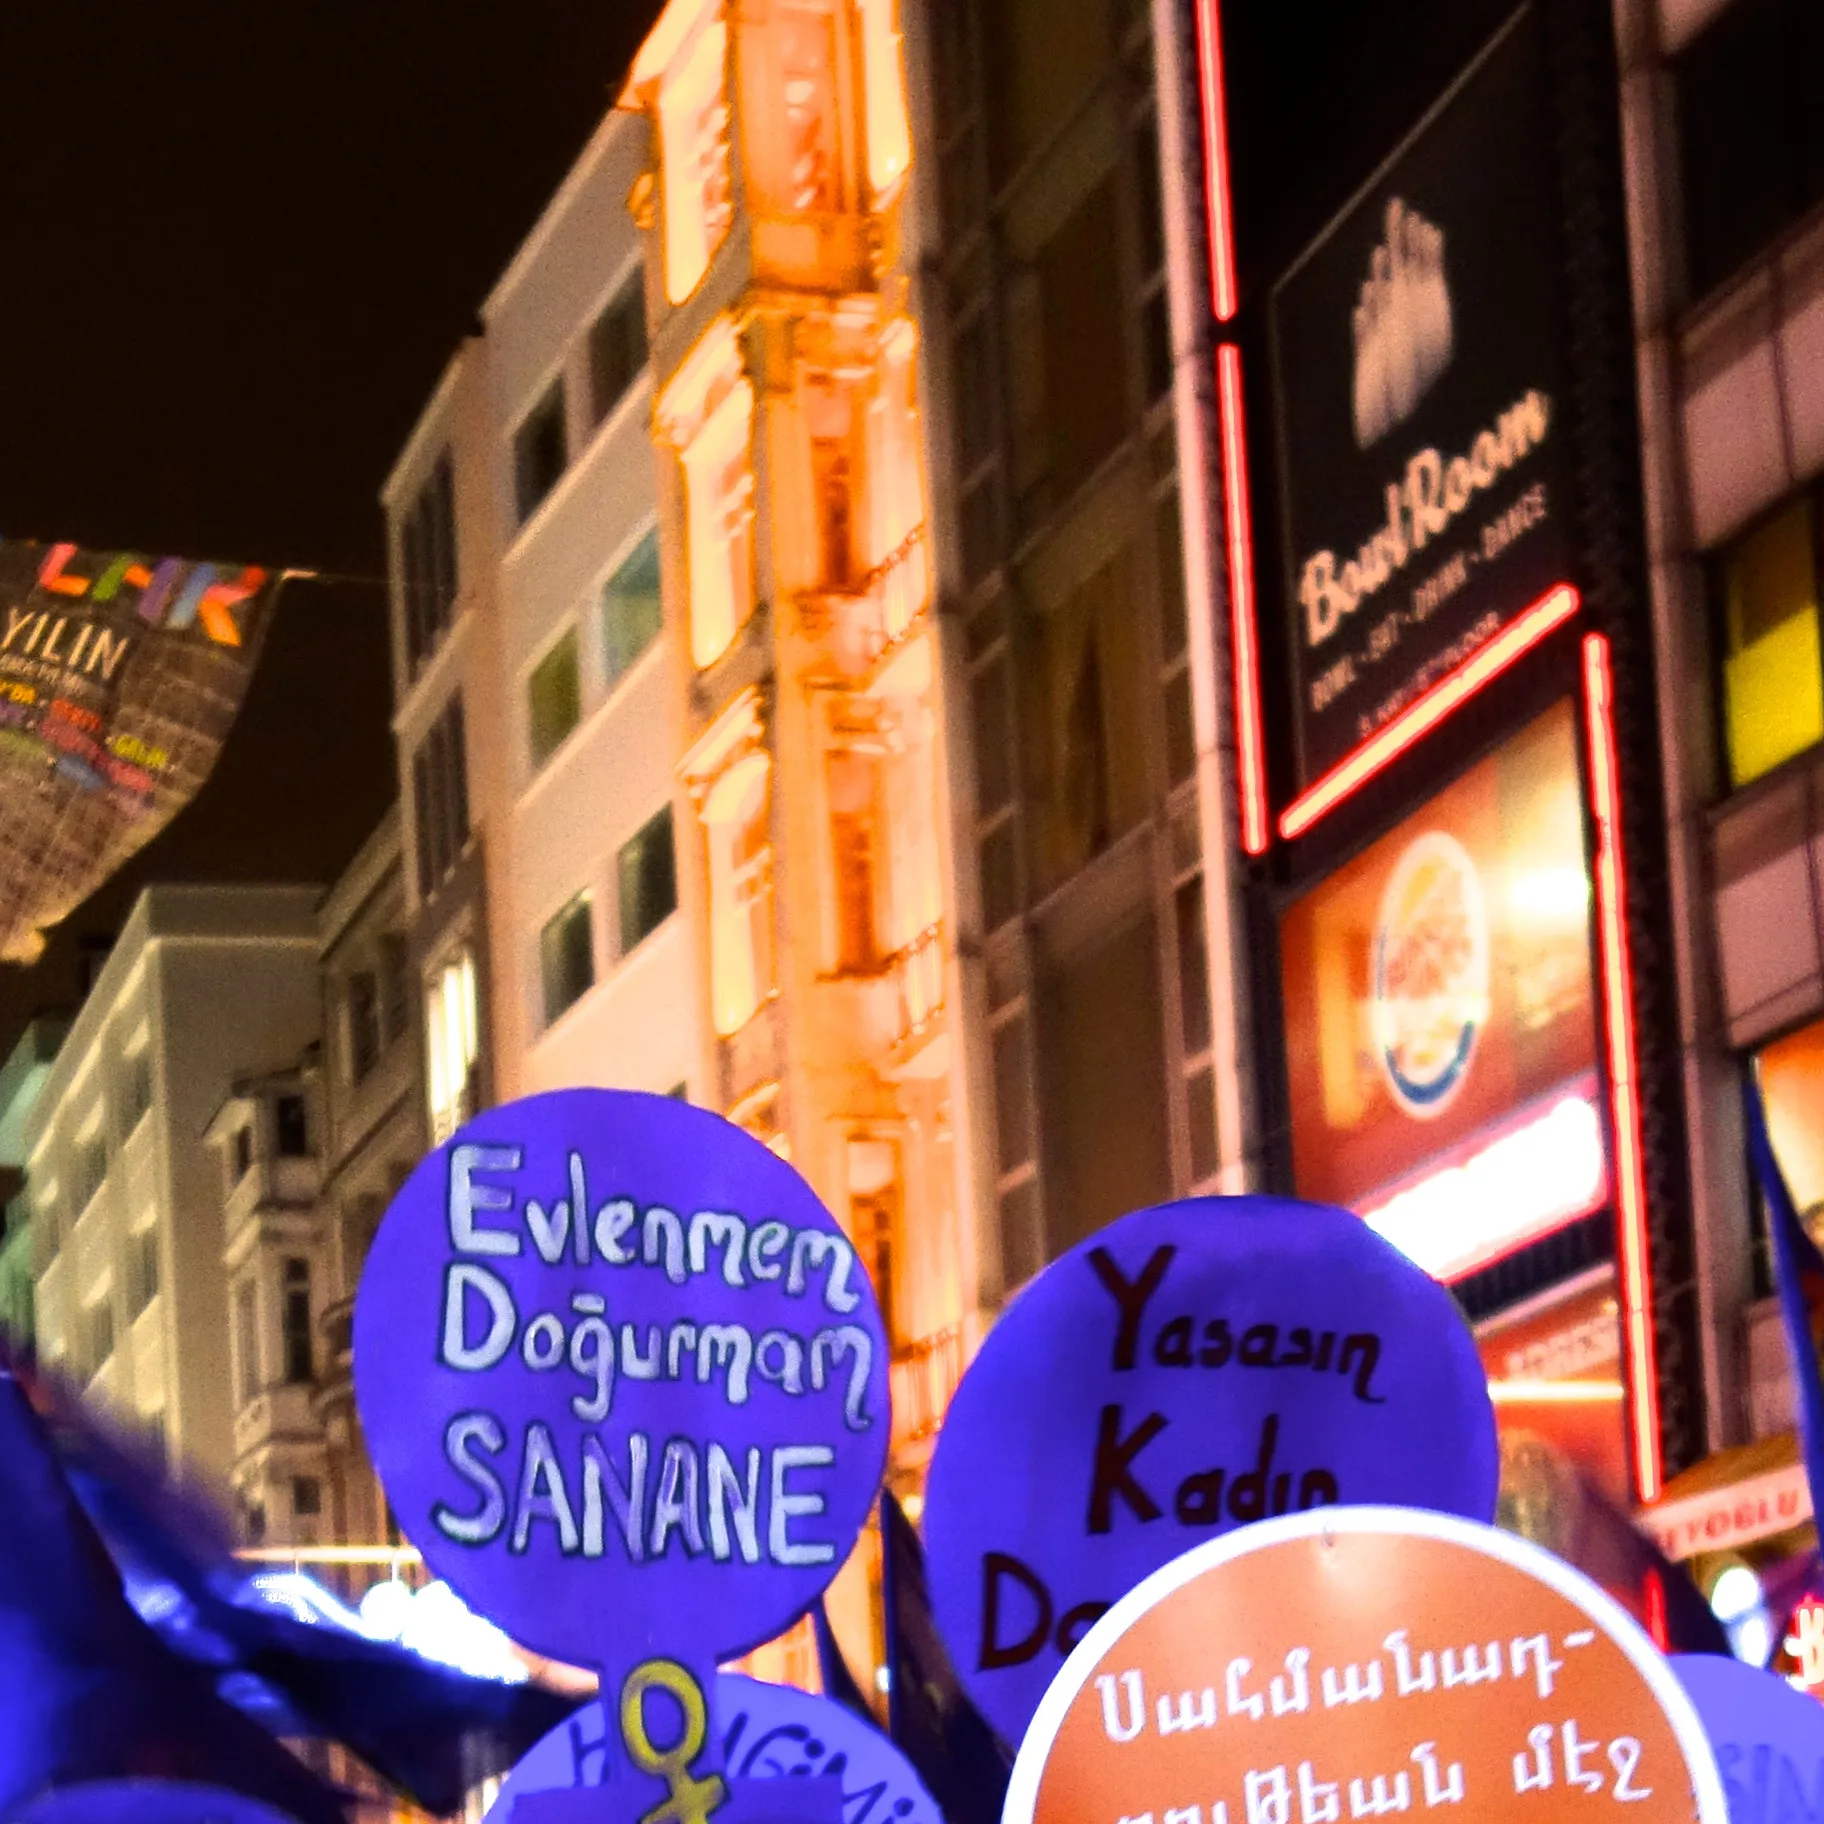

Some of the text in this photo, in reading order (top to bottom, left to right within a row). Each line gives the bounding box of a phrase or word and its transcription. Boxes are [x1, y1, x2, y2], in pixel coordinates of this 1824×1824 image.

[0, 604, 132, 682] YILIN
[447, 1142, 862, 1314] Evlenmem
[440, 1261, 876, 1431] Doğurmam
[432, 1411, 837, 1566] SANANE
[1085, 1403, 1339, 1536] Kadın
[1093, 1627, 1596, 1745] Սահմանադ-
[1512, 1717, 1656, 1803] մէջ
